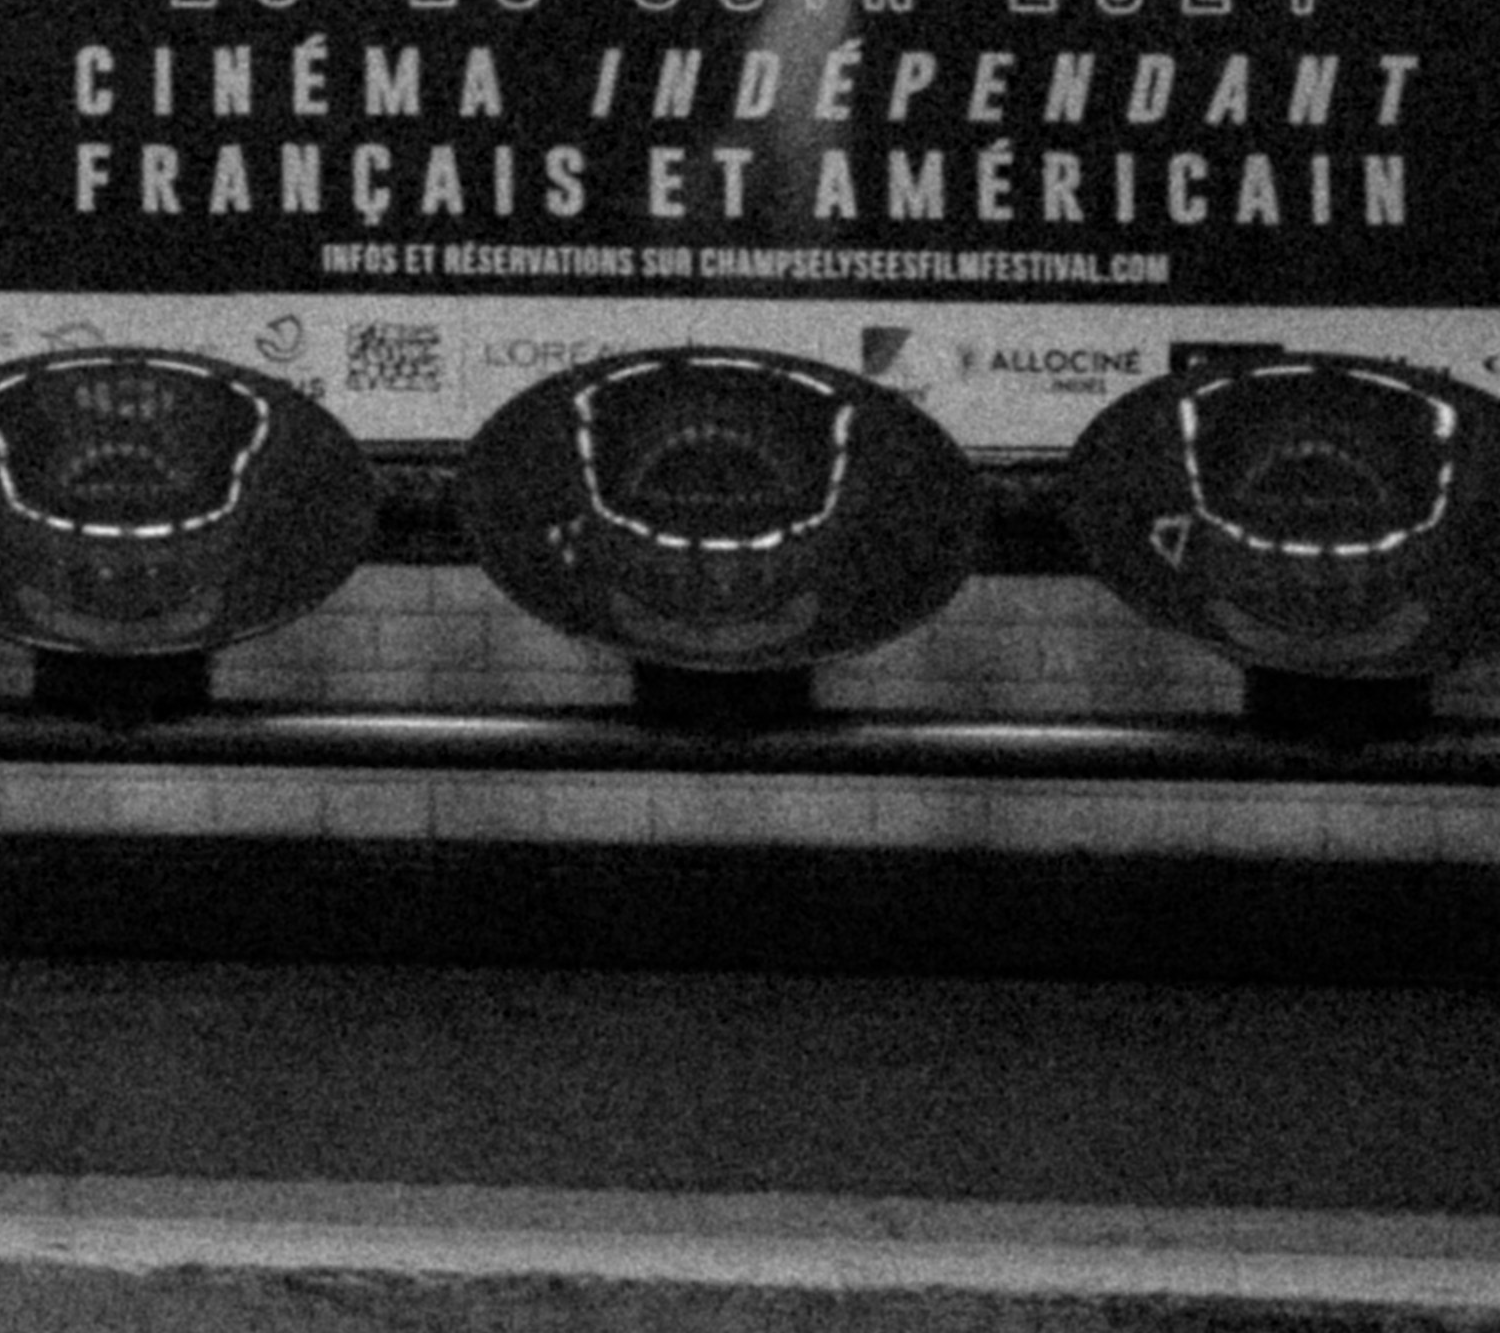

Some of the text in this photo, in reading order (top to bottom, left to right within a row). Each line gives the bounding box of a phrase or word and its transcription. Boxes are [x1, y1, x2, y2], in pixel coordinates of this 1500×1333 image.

[75, 33, 1420, 126] CINÉMA INDÉPENDANT
[76, 138, 1406, 226] FRANÇAIS ET AMÉRICAIN
[321, 240, 1170, 285] INFOS ET RÉSERVATIONS SUR CHAMPSELYSEESFILMFESTIVAL.COM
[989, 346, 1143, 374] ALLOCINÉ
